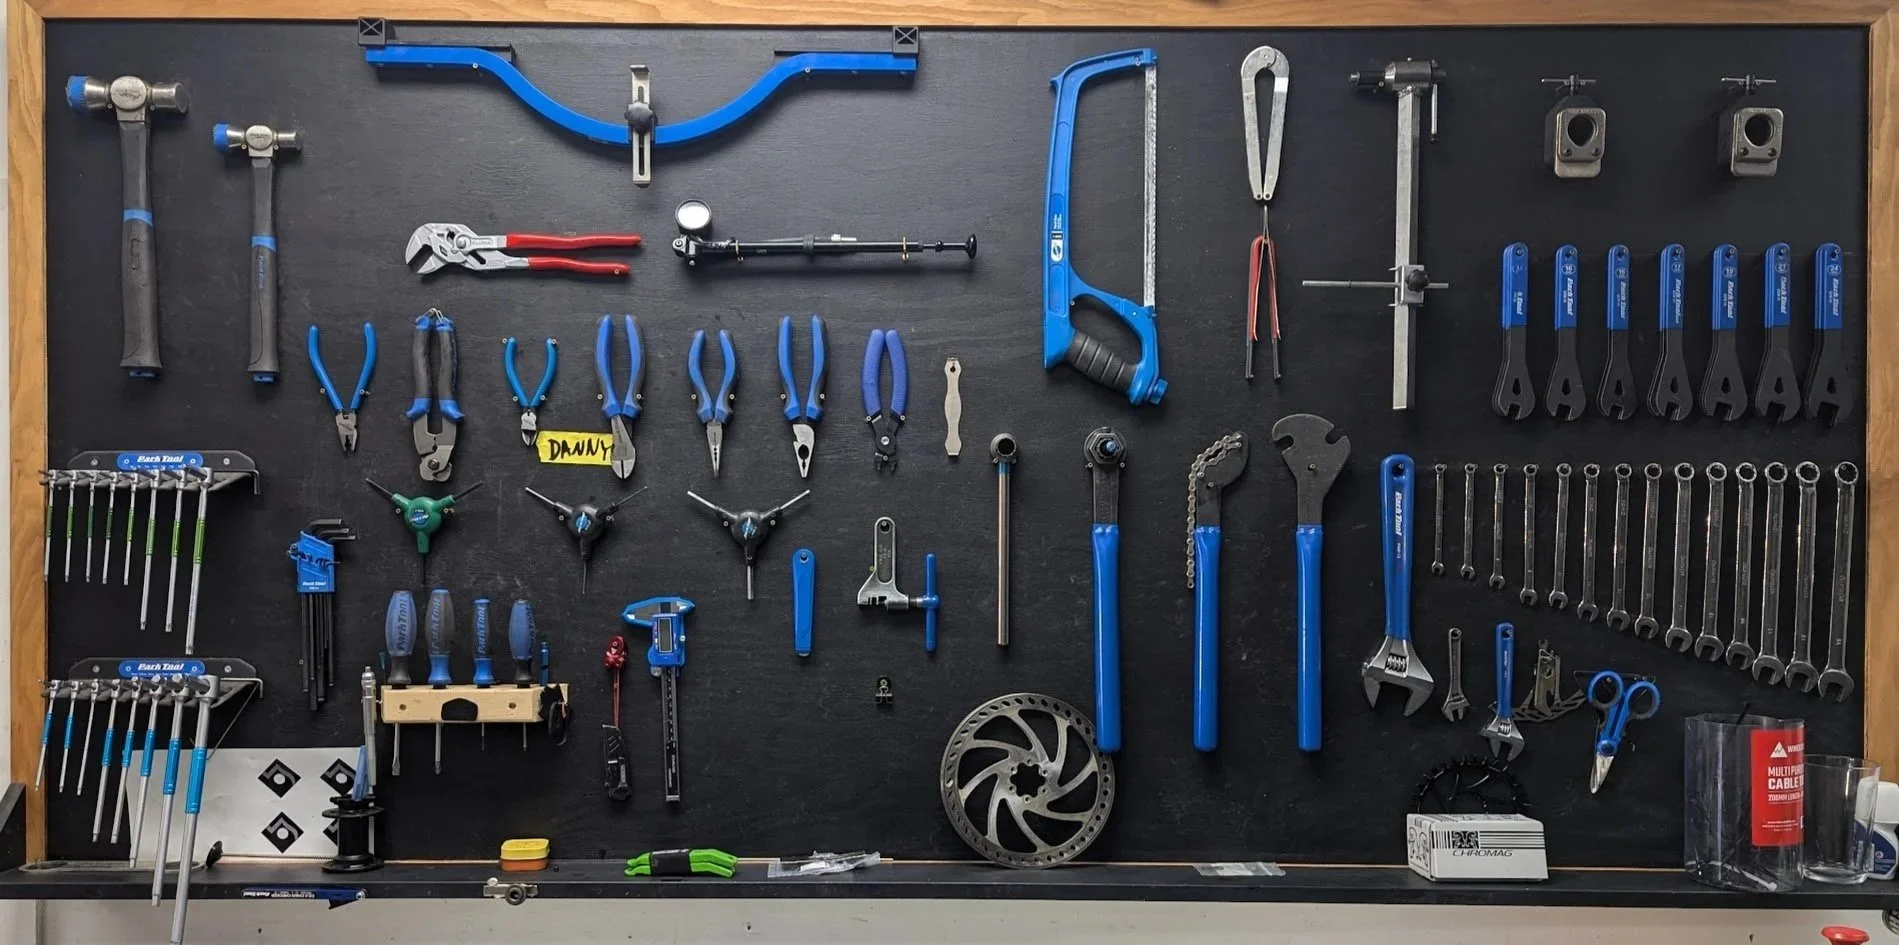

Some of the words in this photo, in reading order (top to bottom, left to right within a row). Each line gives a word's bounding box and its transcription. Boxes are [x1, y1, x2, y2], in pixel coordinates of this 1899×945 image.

[548, 438, 615, 461] DANNY
[1768, 765, 1790, 777] MULTI
[1768, 775, 1799, 790] CABLE
[1452, 849, 1513, 857] CHROMAG
